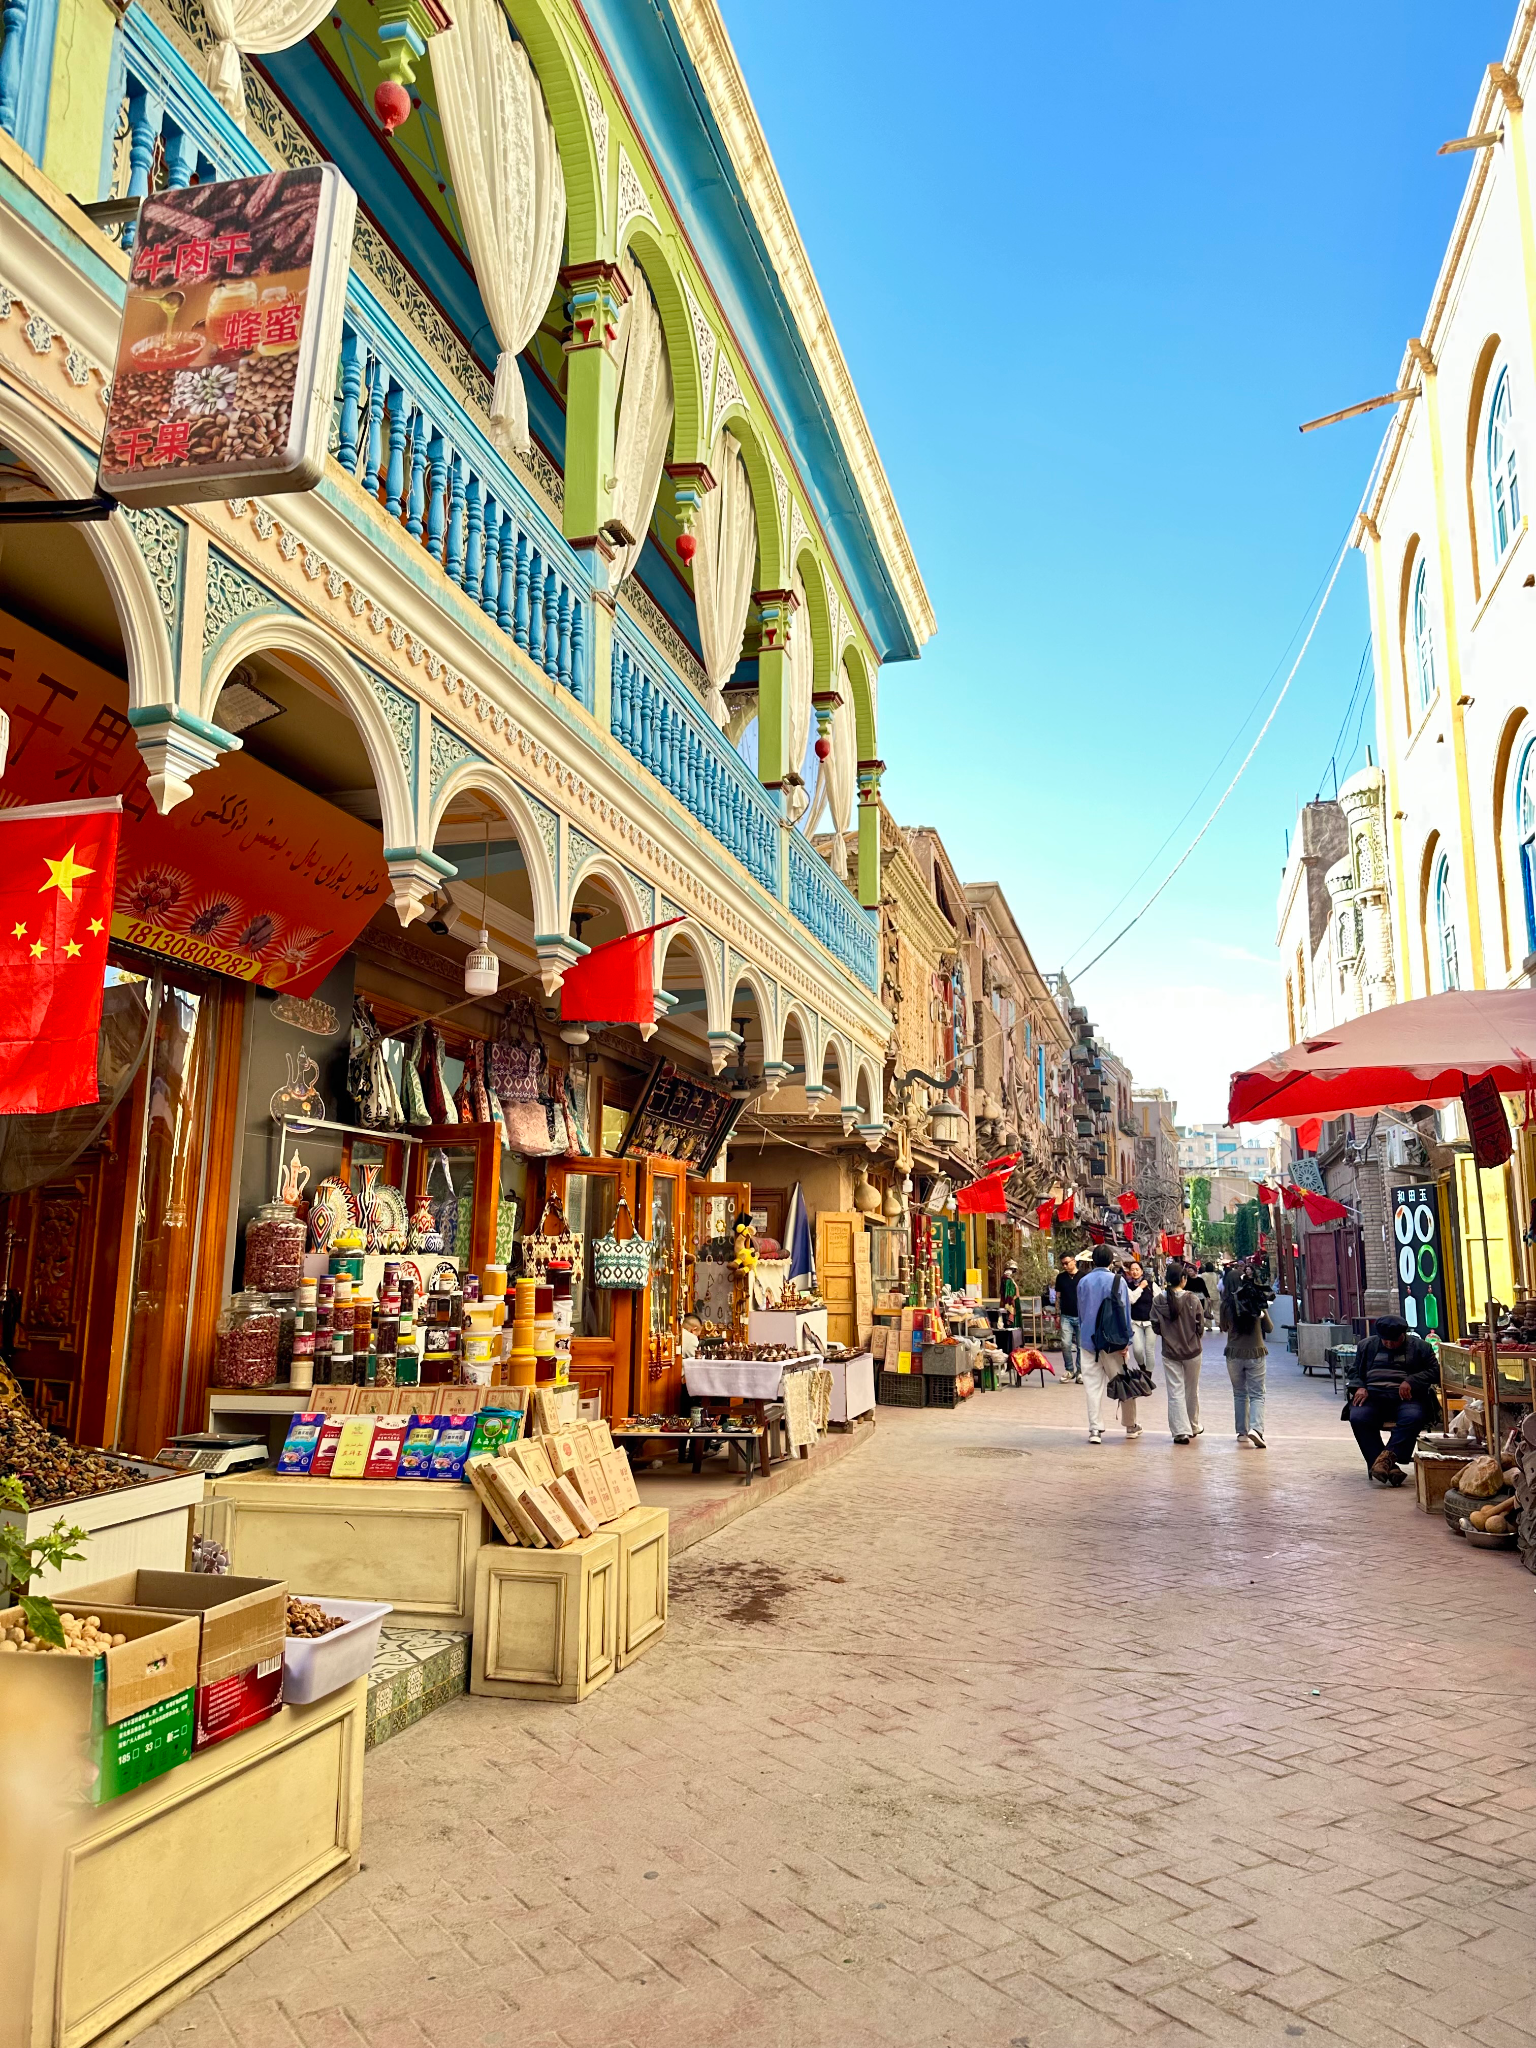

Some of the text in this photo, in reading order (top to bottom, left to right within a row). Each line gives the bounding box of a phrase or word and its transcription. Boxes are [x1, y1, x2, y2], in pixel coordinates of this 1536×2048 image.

[137, 232, 251, 283] 牛肉干
[223, 304, 302, 351] 蜂蜜
[116, 422, 191, 467] 干果
[125, 922, 254, 978] 18130808282
[1397, 1188, 1428, 1204] 和田玉
[118, 1752, 131, 1765] 185
[144, 1741, 154, 1753] 33
